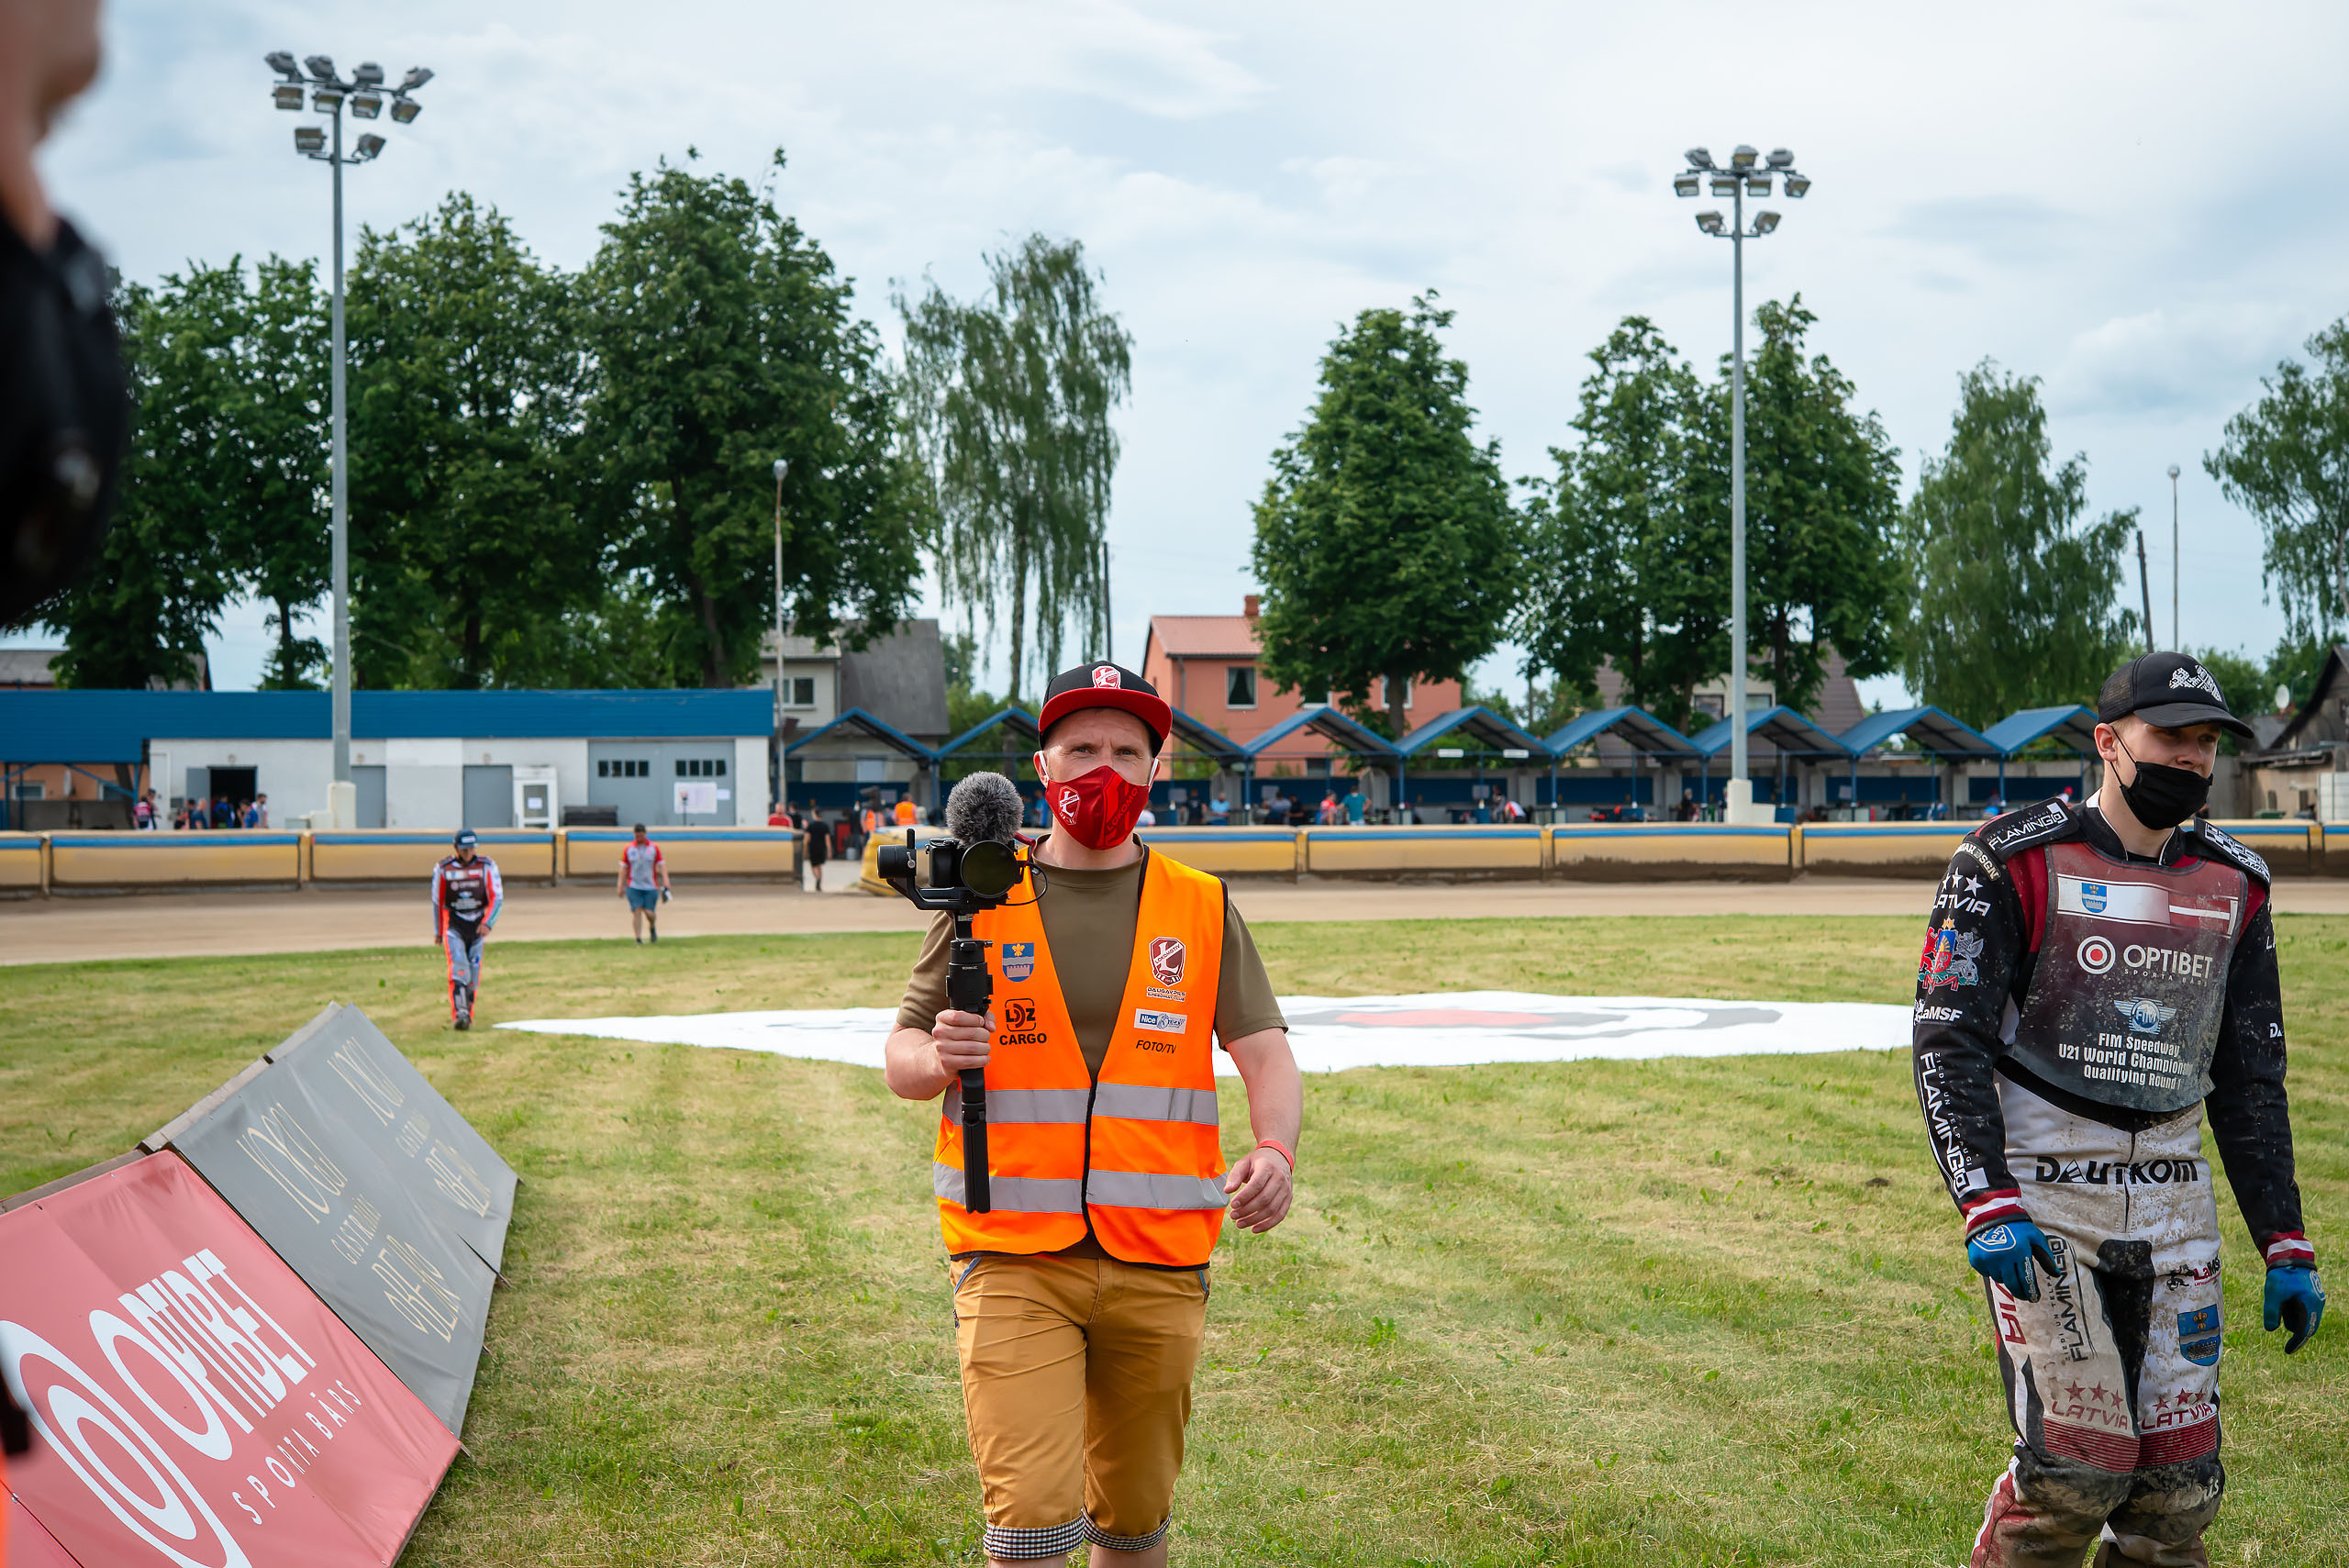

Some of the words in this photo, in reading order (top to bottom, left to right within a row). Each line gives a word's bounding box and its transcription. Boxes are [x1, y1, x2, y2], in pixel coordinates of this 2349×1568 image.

[1988, 810, 2066, 851] FLAMINGO
[1933, 895, 1991, 917] LATVIA
[1154, 943, 1180, 964] LOKOMOTIV
[2123, 944, 2213, 979] OPTIBET
[2124, 968, 2173, 981] SPORTA
[1147, 986, 1186, 996] DAUGAVPILS
[1141, 1015, 1156, 1024] Nice
[2135, 1010, 2157, 1025] FIM
[999, 1033, 1047, 1045] CARGO
[1136, 1040, 1176, 1053] FOTO/TV
[2099, 1032, 2122, 1048] FIM
[2126, 1036, 2180, 1058] Speedway
[2058, 1043, 2079, 1061] U21
[2083, 1046, 2127, 1066] World
[2084, 1064, 2145, 1085] Qualifying
[2149, 1073, 2176, 1090] Round
[1935, 1052, 1945, 1085] ZIEDI
[1943, 1092, 1951, 1106] UN
[1947, 1112, 1973, 1166] TELPAUGI
[1920, 1052, 1971, 1193] FLAMINGO
[2035, 1156, 2199, 1185] DAUTKOM
[2193, 1257, 2221, 1281] LaMS
[2046, 1275, 2055, 1307] TELPA
[2051, 1238, 2088, 1362] FLAMINGO
[89, 1248, 317, 1461] OPTIBET
[2052, 1401, 2128, 1430] LATVIA
[2141, 1402, 2213, 1430] LATVIA
[231, 1429, 320, 1525] SPORTA
[306, 1379, 362, 1440] BĀRS
